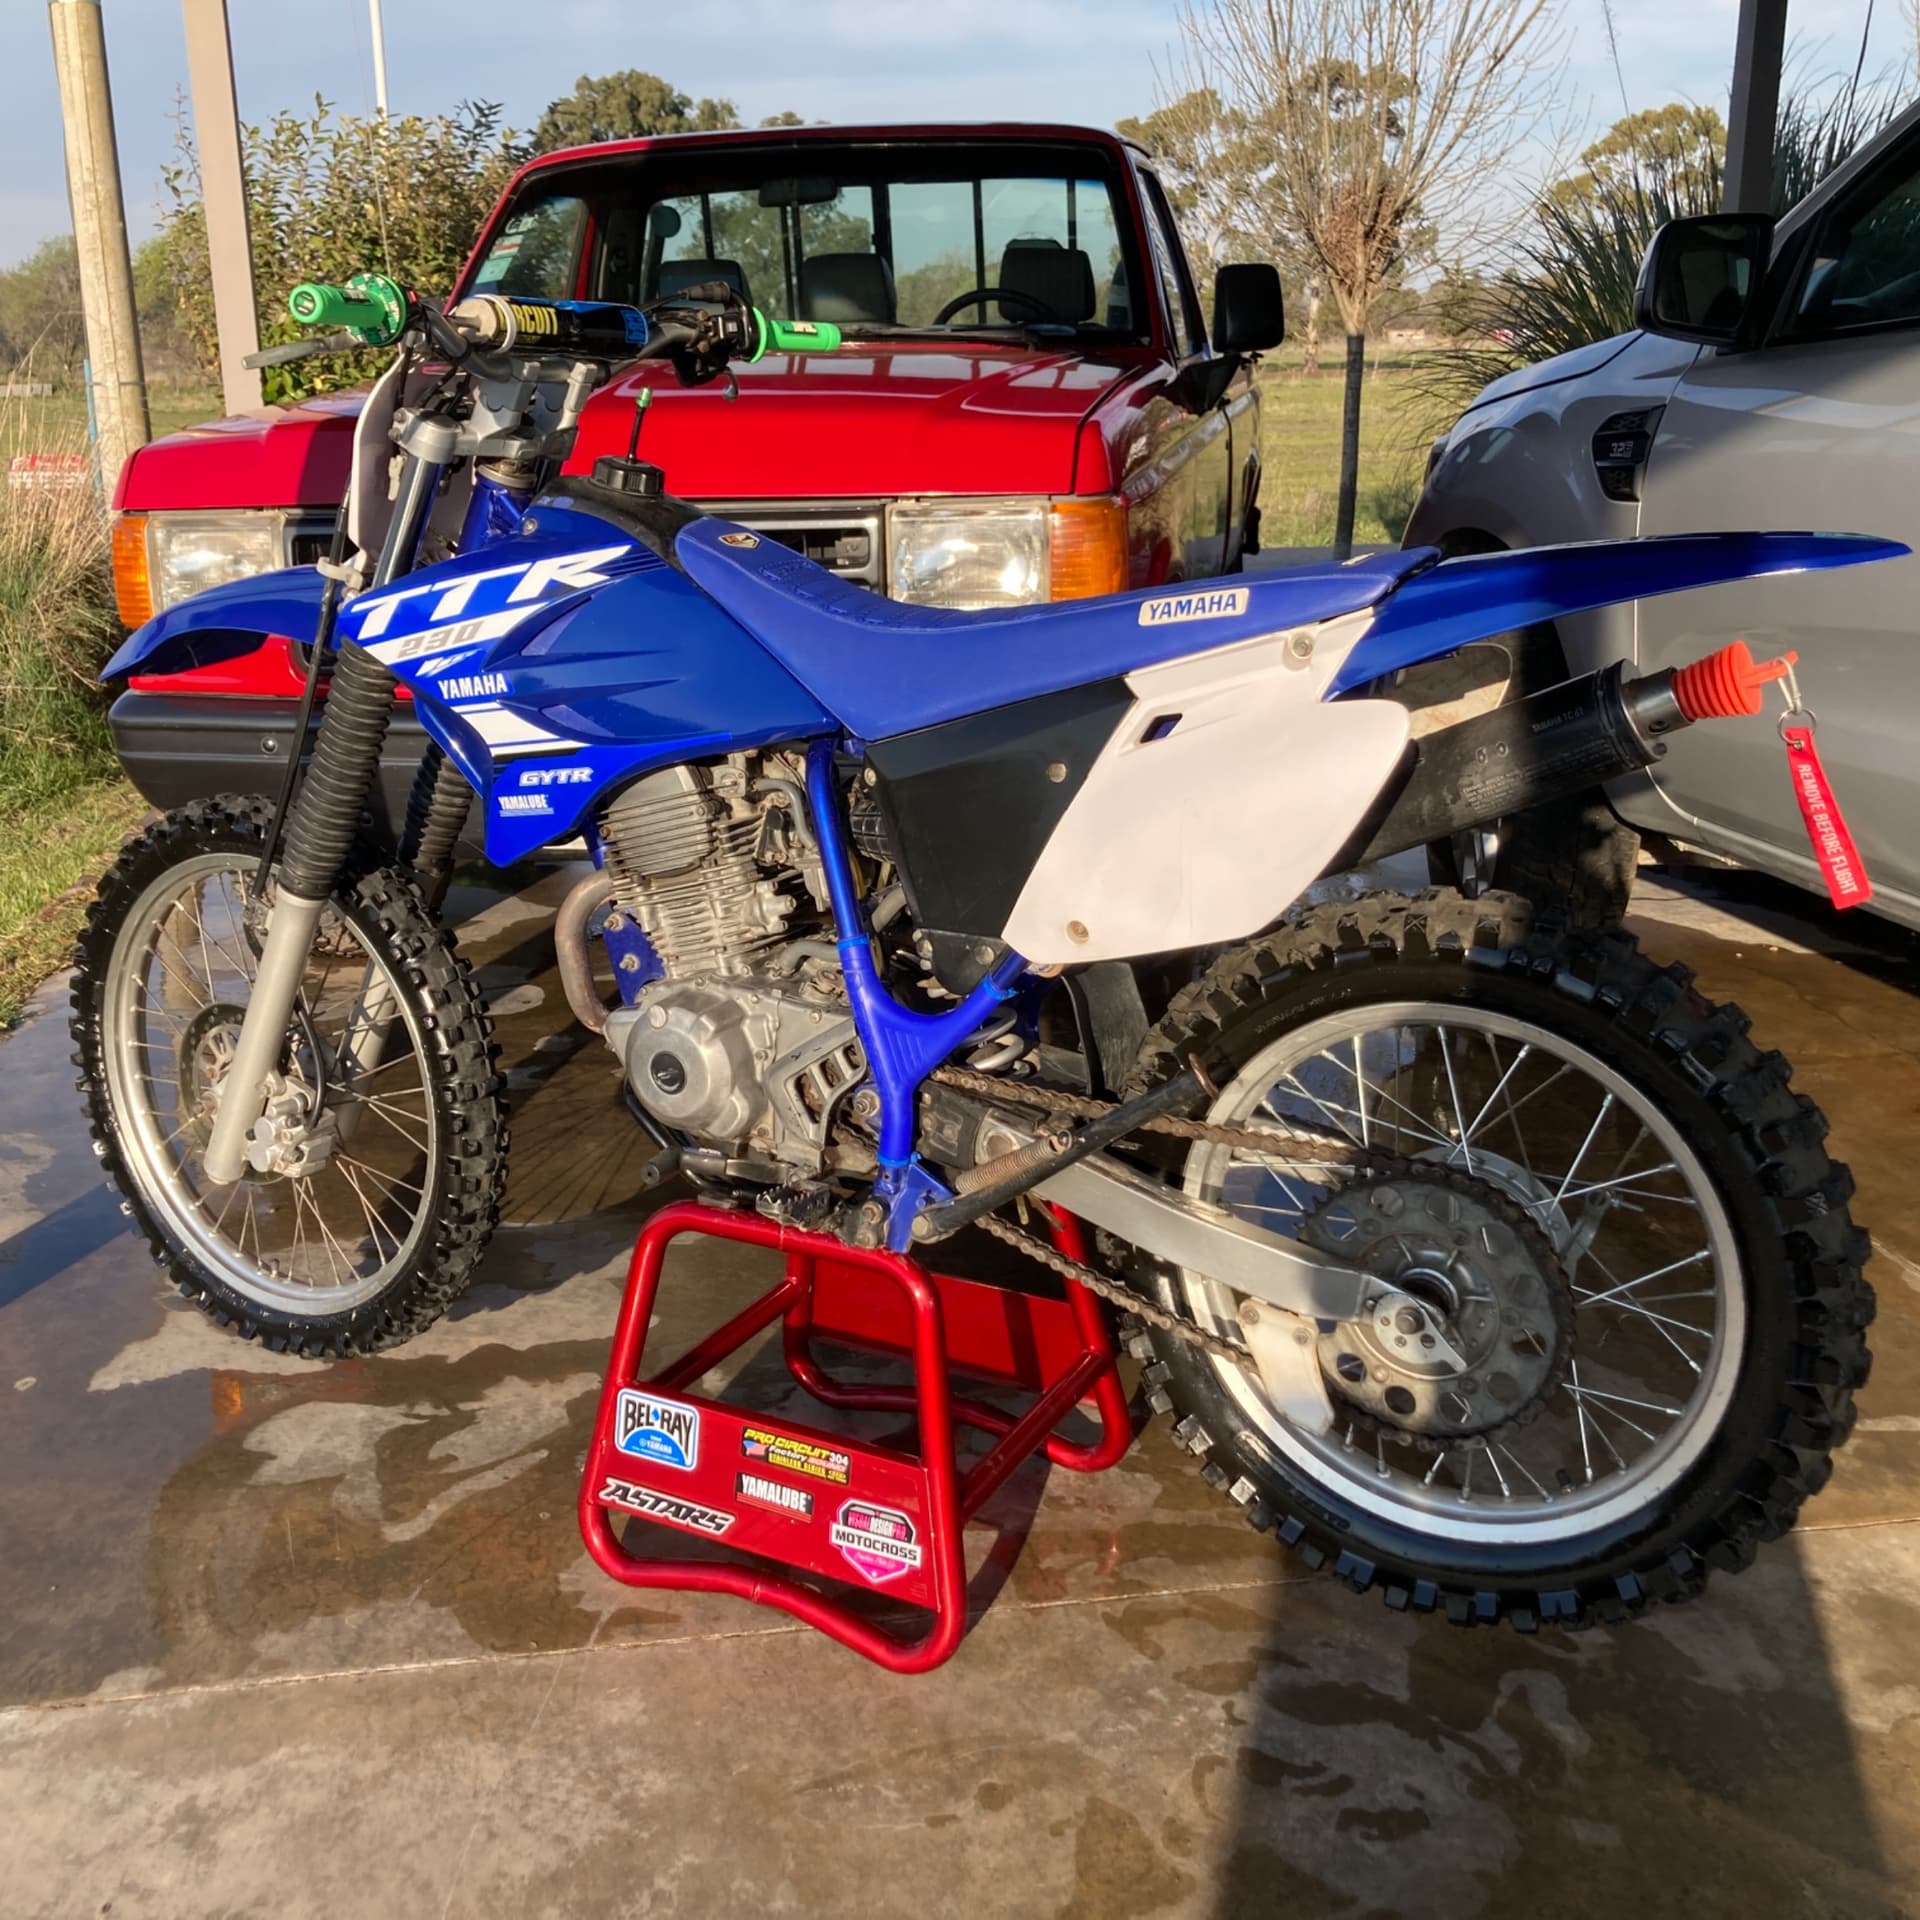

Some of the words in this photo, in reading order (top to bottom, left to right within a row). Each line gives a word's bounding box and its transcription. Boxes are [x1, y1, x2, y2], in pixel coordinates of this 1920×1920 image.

[351, 545, 632, 640] TTR
[1150, 593, 1237, 620] YAMAHA
[397, 620, 484, 659] 230
[438, 672, 508, 699] YAMAHA
[519, 766, 594, 787] GYTR
[498, 793, 549, 811] YAMALUBE
[1797, 763, 1826, 812] REMOVE
[1813, 812, 1843, 856] BEFORE
[1830, 854, 1859, 895] FLIGHT
[744, 1428, 776, 1446] PRO
[774, 1437, 831, 1459] CIRCUIT
[829, 1452, 849, 1466] 304
[602, 1481, 732, 1533] ASTARS
[741, 1473, 809, 1513] YAMALUBE
[835, 1529, 918, 1562] MOTOCROSS
